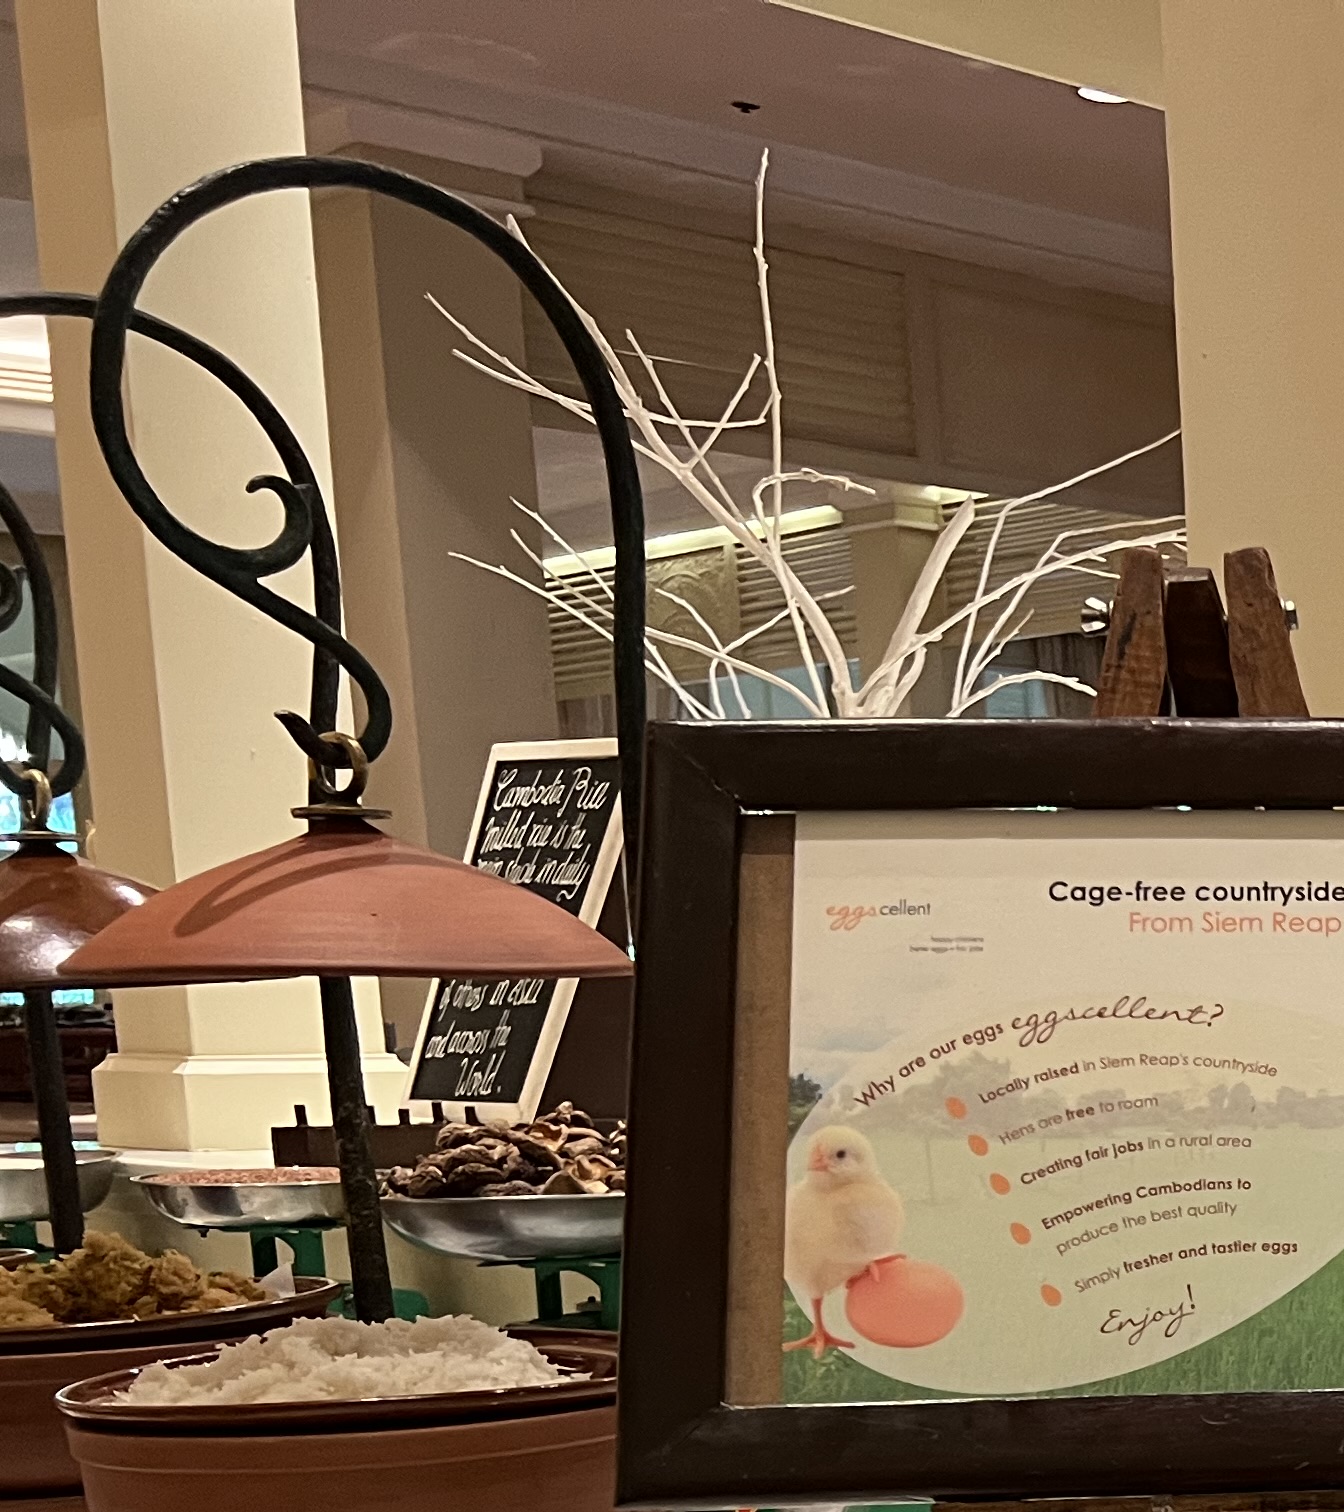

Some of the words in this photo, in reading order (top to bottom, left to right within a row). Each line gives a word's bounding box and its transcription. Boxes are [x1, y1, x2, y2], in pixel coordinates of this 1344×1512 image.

[493, 769, 566, 811] Cambodia
[557, 767, 610, 817] Rice
[526, 818, 553, 847] rice
[550, 820, 569, 848] is
[563, 813, 587, 850] the
[535, 857, 558, 885] in
[551, 844, 591, 902] daily
[1048, 880, 1186, 907] Cage-free
[826, 899, 931, 931] eggscellent
[1128, 911, 1194, 933] From
[1201, 911, 1264, 933] Siem
[1272, 911, 1342, 938] Reap
[425, 1020, 457, 1059] and
[489, 1009, 512, 1049] the
[853, 1075, 896, 1109] Why
[898, 1055, 926, 1079] are
[929, 1038, 957, 1060] our
[962, 1022, 1004, 1048] eggs
[1011, 995, 1225, 1048] eggscellent?
[978, 1076, 1030, 1104] Locally
[1034, 1062, 1079, 1084] raised
[1083, 1060, 1096, 1072] in
[1100, 1056, 1136, 1070] Siem
[1139, 1053, 1189, 1068] Reap's
[1193, 1055, 1278, 1078] countryside
[999, 1124, 1035, 1146] Hens
[1038, 1113, 1063, 1130] are
[1065, 1104, 1095, 1122] free
[1099, 1101, 1115, 1113] to
[1117, 1095, 1159, 1110] roam
[1020, 1154, 1083, 1185] Creating
[1085, 1146, 1109, 1163] fair
[1112, 1139, 1144, 1159] jobs
[1147, 1137, 1161, 1150] in
[1164, 1138, 1176, 1149] a
[1179, 1134, 1213, 1147] rural
[1216, 1135, 1252, 1148] area
[1041, 1191, 1132, 1230] Empowering
[1135, 1179, 1233, 1199] Cambodians
[1237, 1178, 1252, 1190] to
[1055, 1221, 1119, 1257] produce
[1122, 1214, 1147, 1230] the
[1150, 1205, 1183, 1223] best
[1187, 1201, 1238, 1218] quality
[1074, 1265, 1121, 1294] Simply
[1123, 1252, 1174, 1274] fresher
[1178, 1244, 1208, 1259] and
[1212, 1240, 1257, 1255] tastier
[1261, 1241, 1299, 1255] eggs
[1100, 1283, 1196, 1346] Enjoy!
